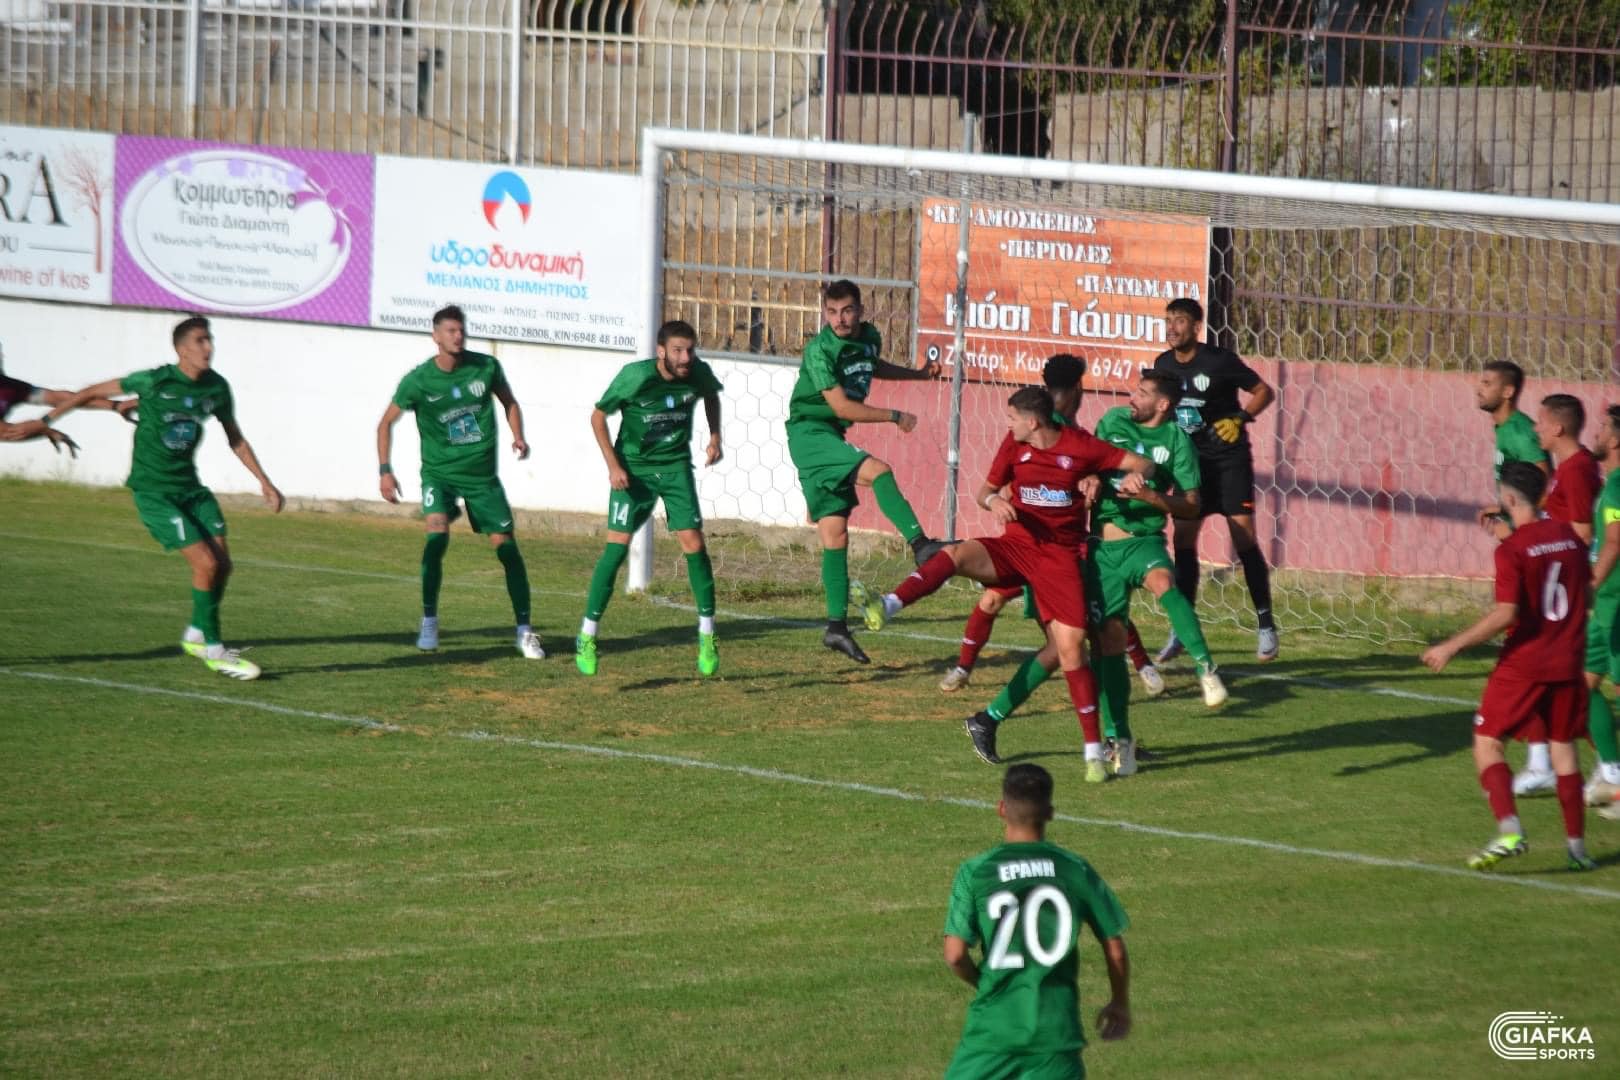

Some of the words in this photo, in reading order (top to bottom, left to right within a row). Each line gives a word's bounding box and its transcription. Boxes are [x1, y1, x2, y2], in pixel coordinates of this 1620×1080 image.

[932, 205, 1097, 234] ΚΕΑΜΟΣΚΕΠΕΣ
[431, 240, 585, 280] υδροδυναμική
[1008, 239, 1112, 264] ΠΕΡΓΟΛΕΣ
[426, 271, 501, 292] ΜΕΛΙΑΝΟΣ
[504, 280, 589, 299] ΔΗΜΗΤΡΙΟΣ
[1085, 274, 1200, 300] ΠΑΤΩΜΑΤΑ
[589, 313, 625, 327] SERVICE
[599, 335, 611, 345] 48
[945, 345, 1008, 374] Ζπάρι,
[1091, 358, 1133, 380] 6947
[423, 487, 435, 507] 6
[612, 502, 629, 526] 14
[1543, 561, 1569, 621] 6
[987, 885, 1073, 970] 20
